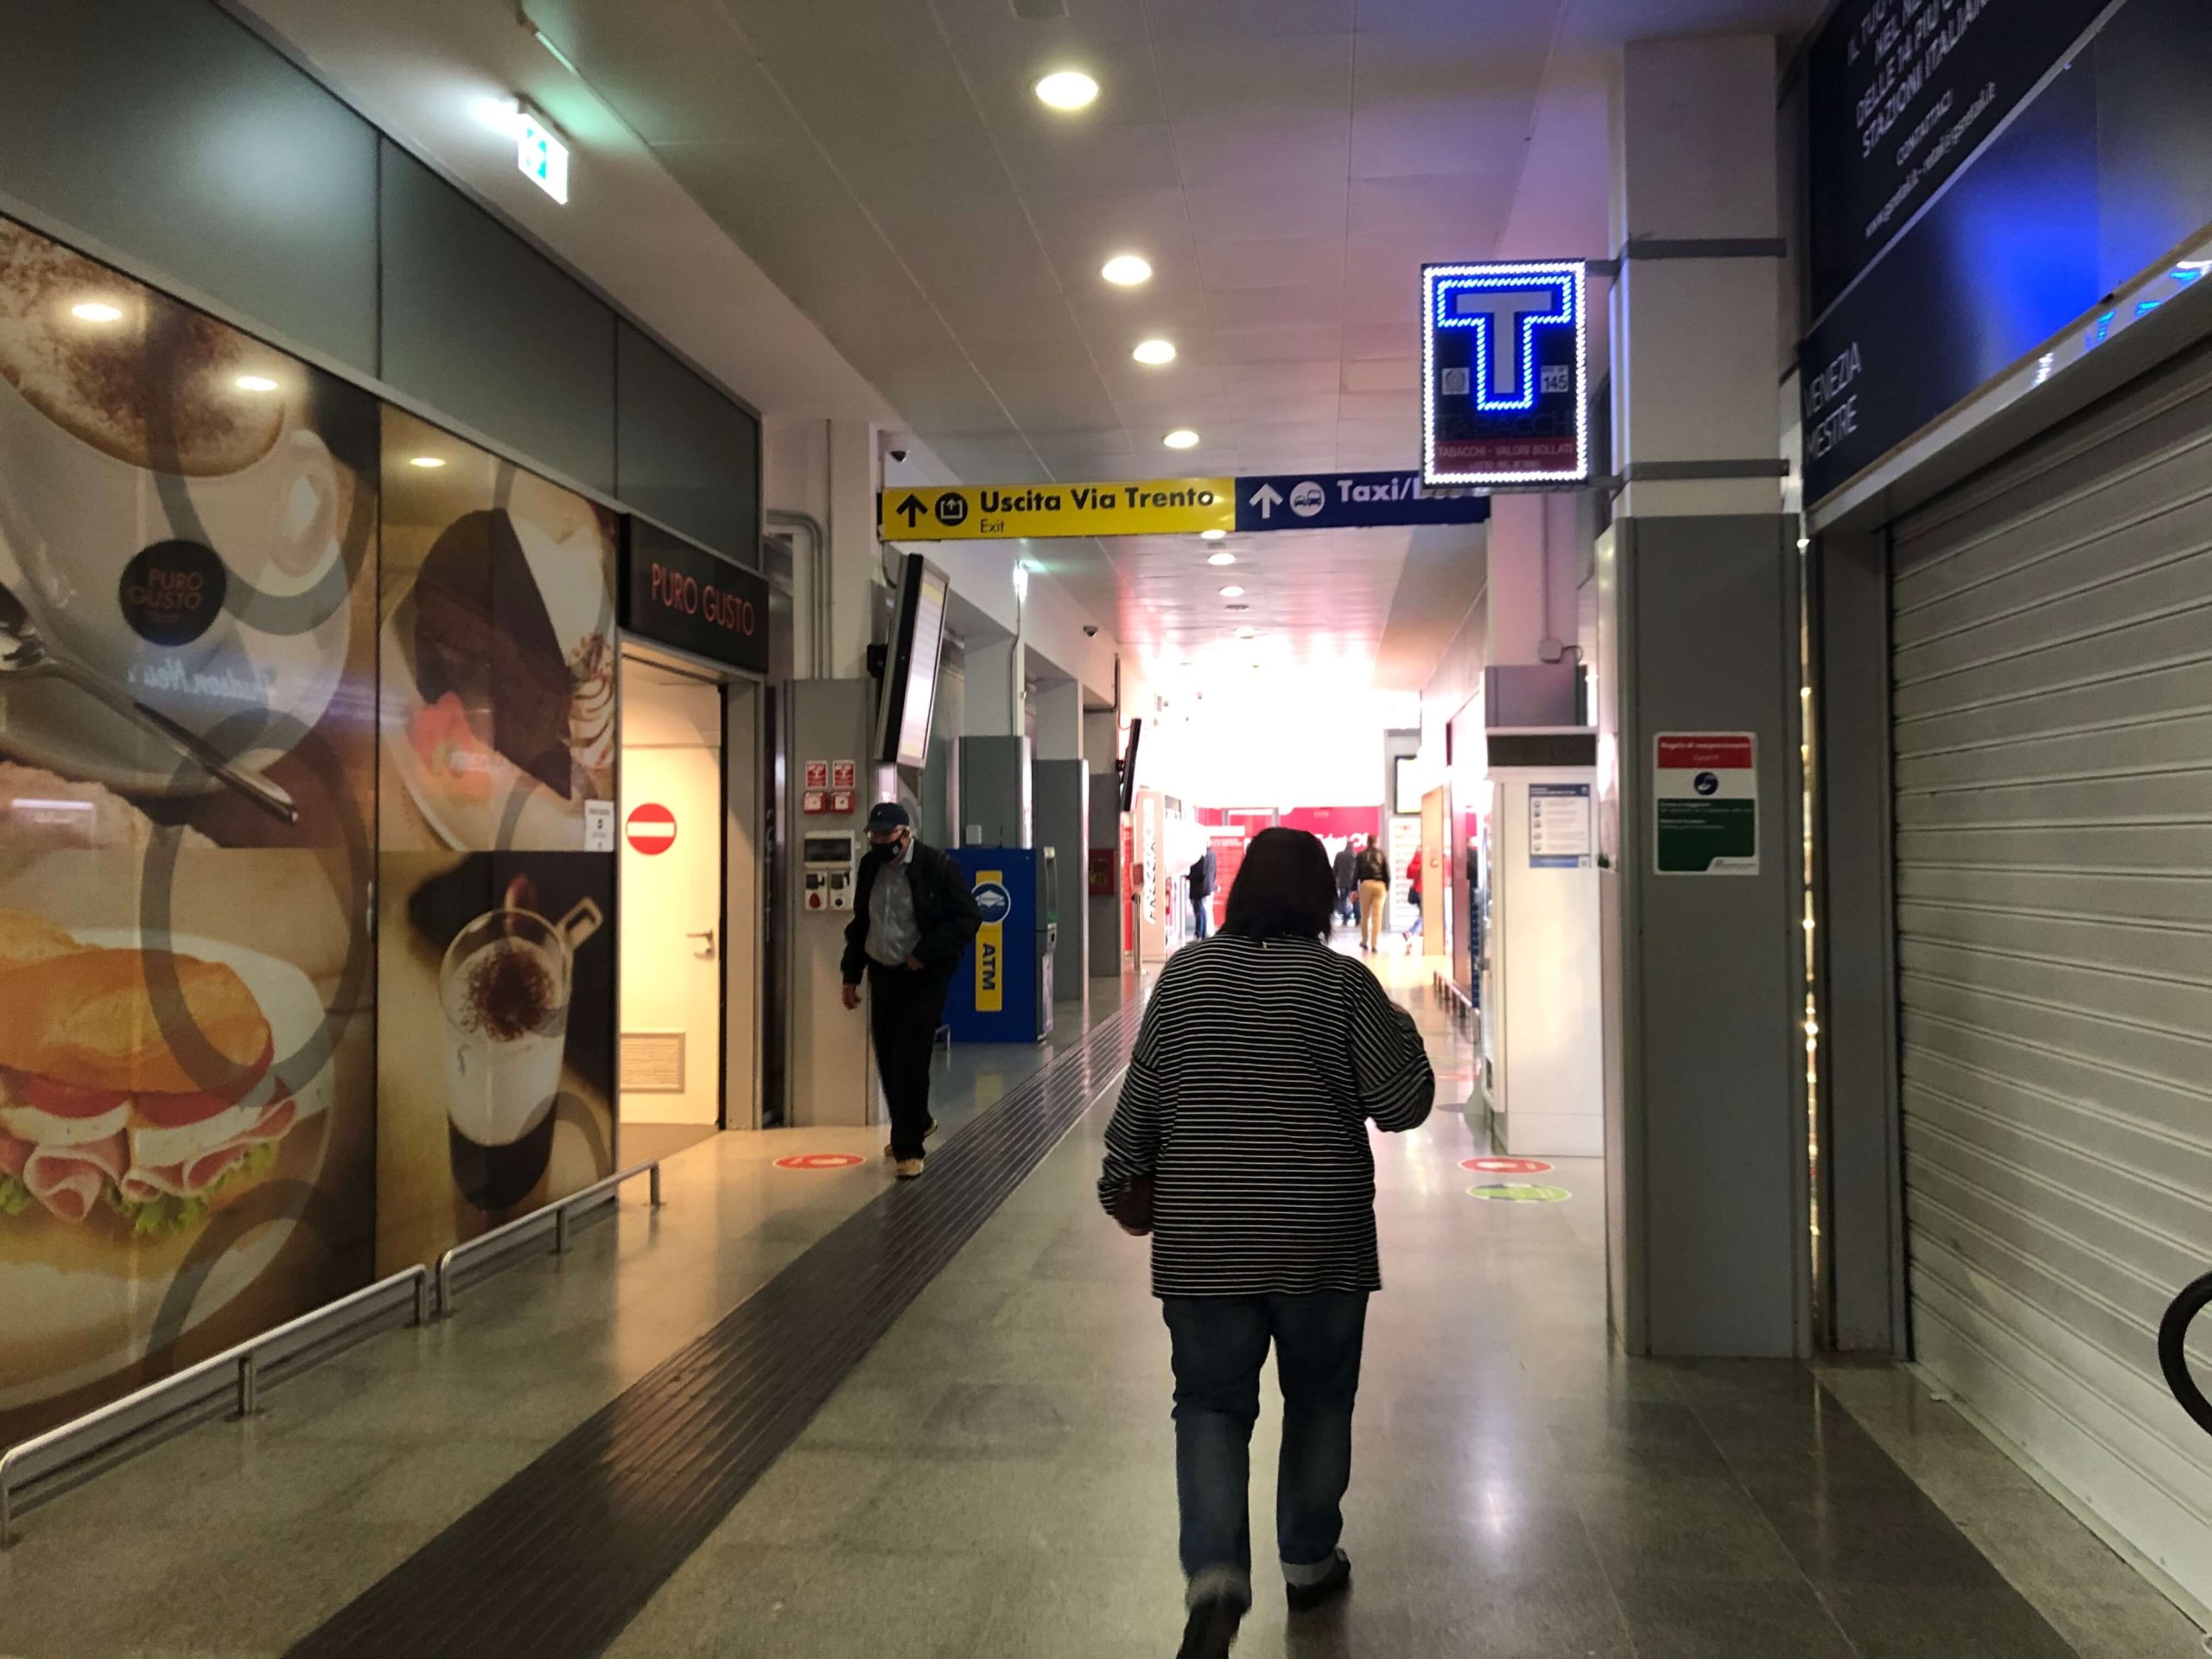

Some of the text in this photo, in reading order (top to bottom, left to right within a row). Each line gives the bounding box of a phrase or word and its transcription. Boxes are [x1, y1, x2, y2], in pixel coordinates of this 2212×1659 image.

[1863, 60, 1923, 158] STAZIONI
[1439, 277, 1568, 409] T
[1544, 374, 1567, 390] 145
[1803, 342, 1862, 418] VENEZIA
[981, 486, 1214, 513] Uscita Via Trento
[980, 518, 1005, 533] Exit
[129, 585, 201, 610] GUSTO
[149, 568, 203, 590] PURO
[652, 562, 754, 636] PURO GUSTO
[982, 942, 996, 991] ATM
